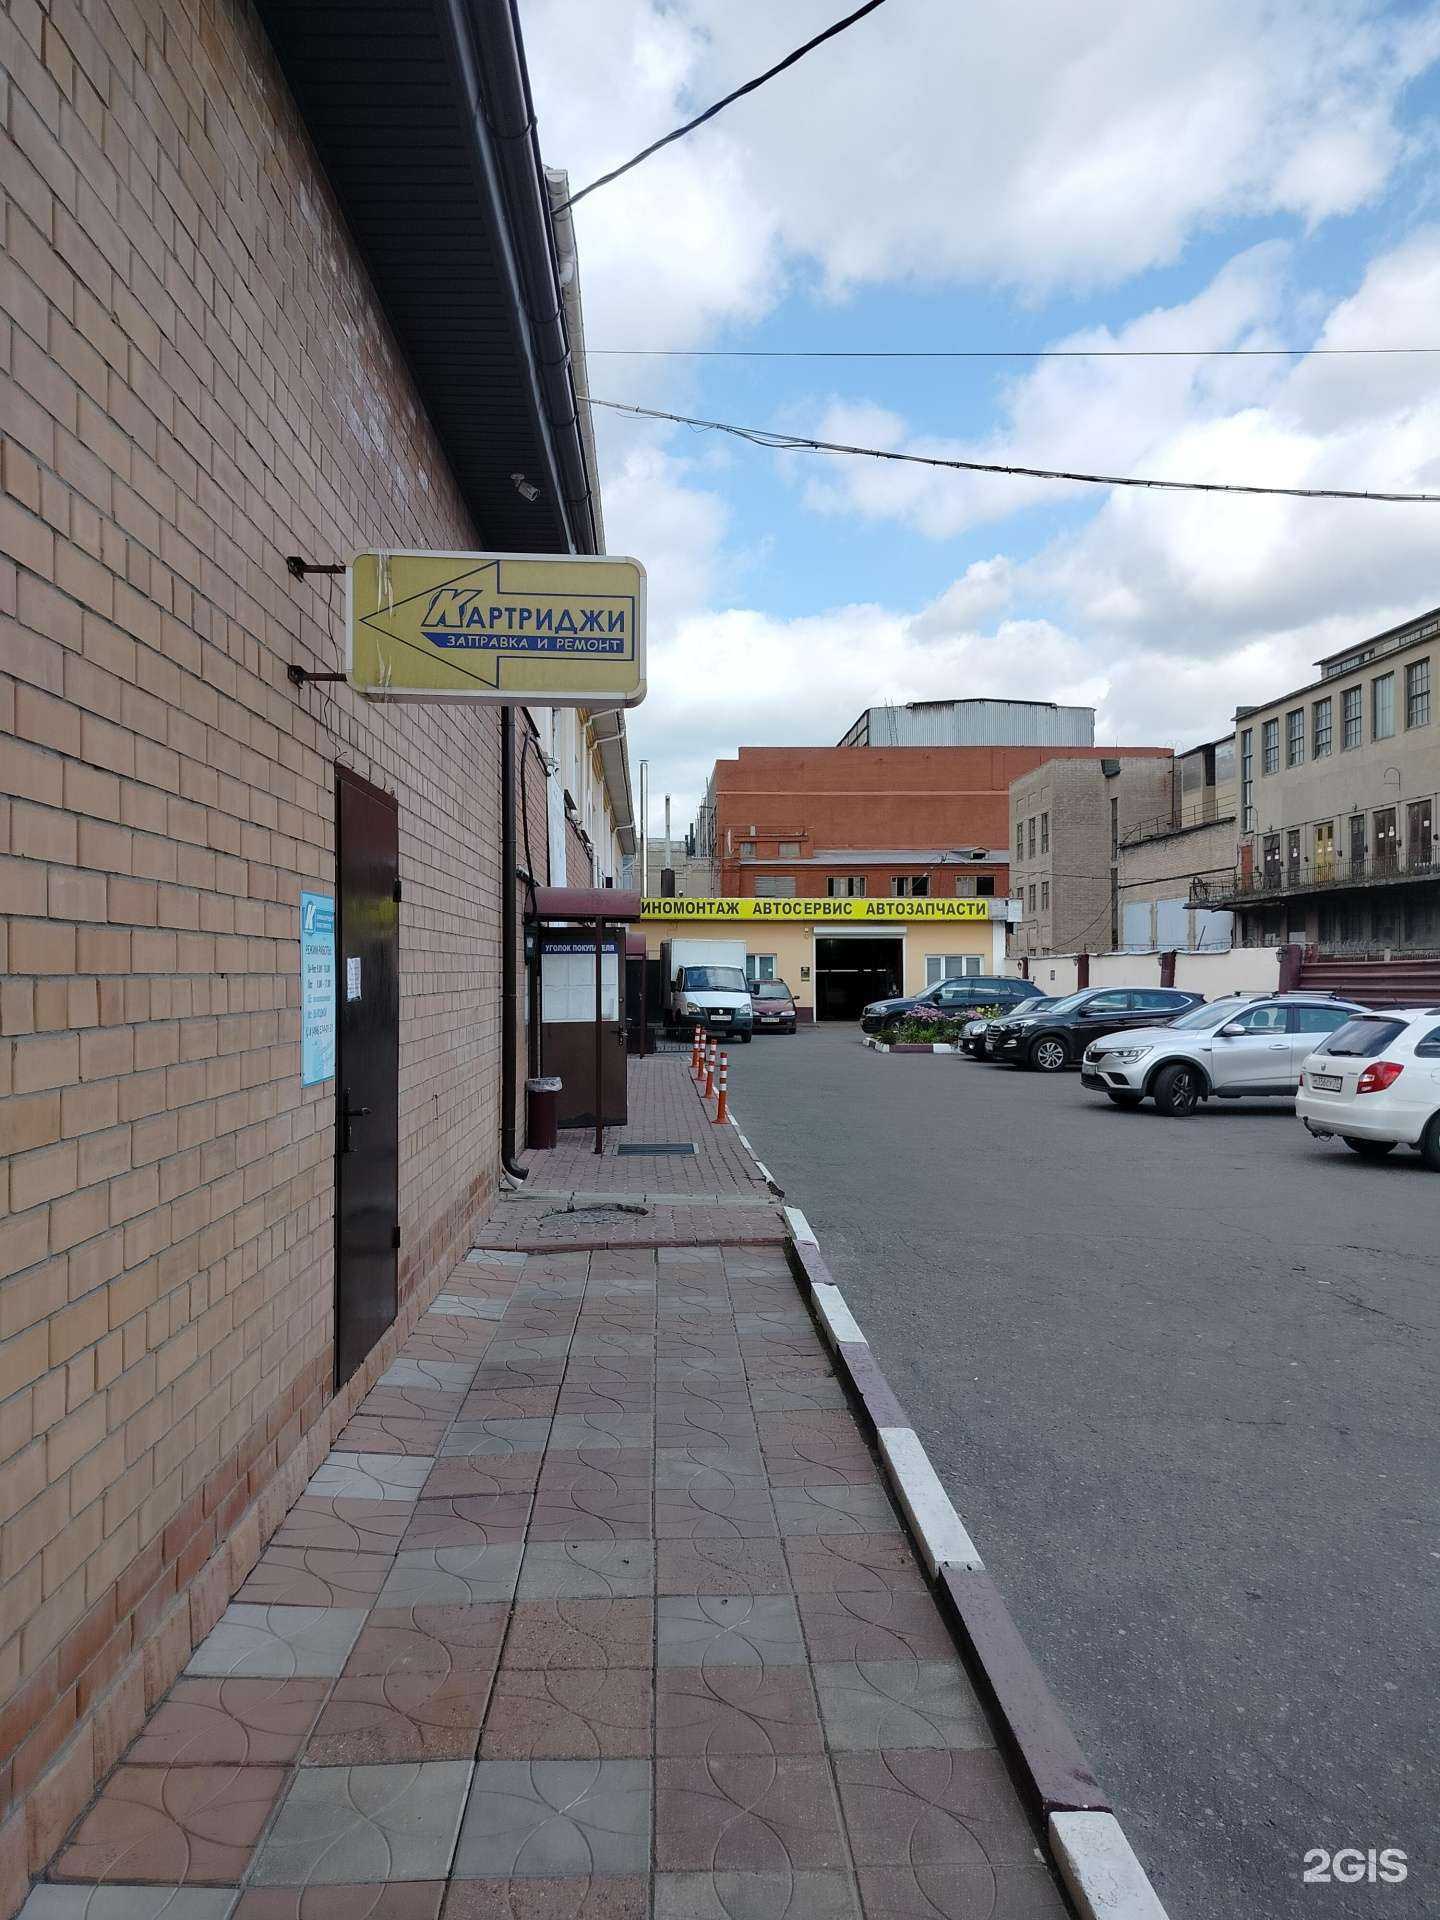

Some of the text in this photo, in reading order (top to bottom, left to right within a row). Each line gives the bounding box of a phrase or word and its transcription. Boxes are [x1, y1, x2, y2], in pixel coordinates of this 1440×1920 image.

[421, 588, 625, 635] КАРТРИДЖИ
[447, 635, 620, 652] ЗАПРАВКА И РЕМОНТ
[641, 901, 987, 916] ИНОМОНТАЖ АВТОСЕРВИС АВТОЗАПЧАСТИ
[545, 944, 615, 952] УГОЛОК ПОКУПЕЛЯ
